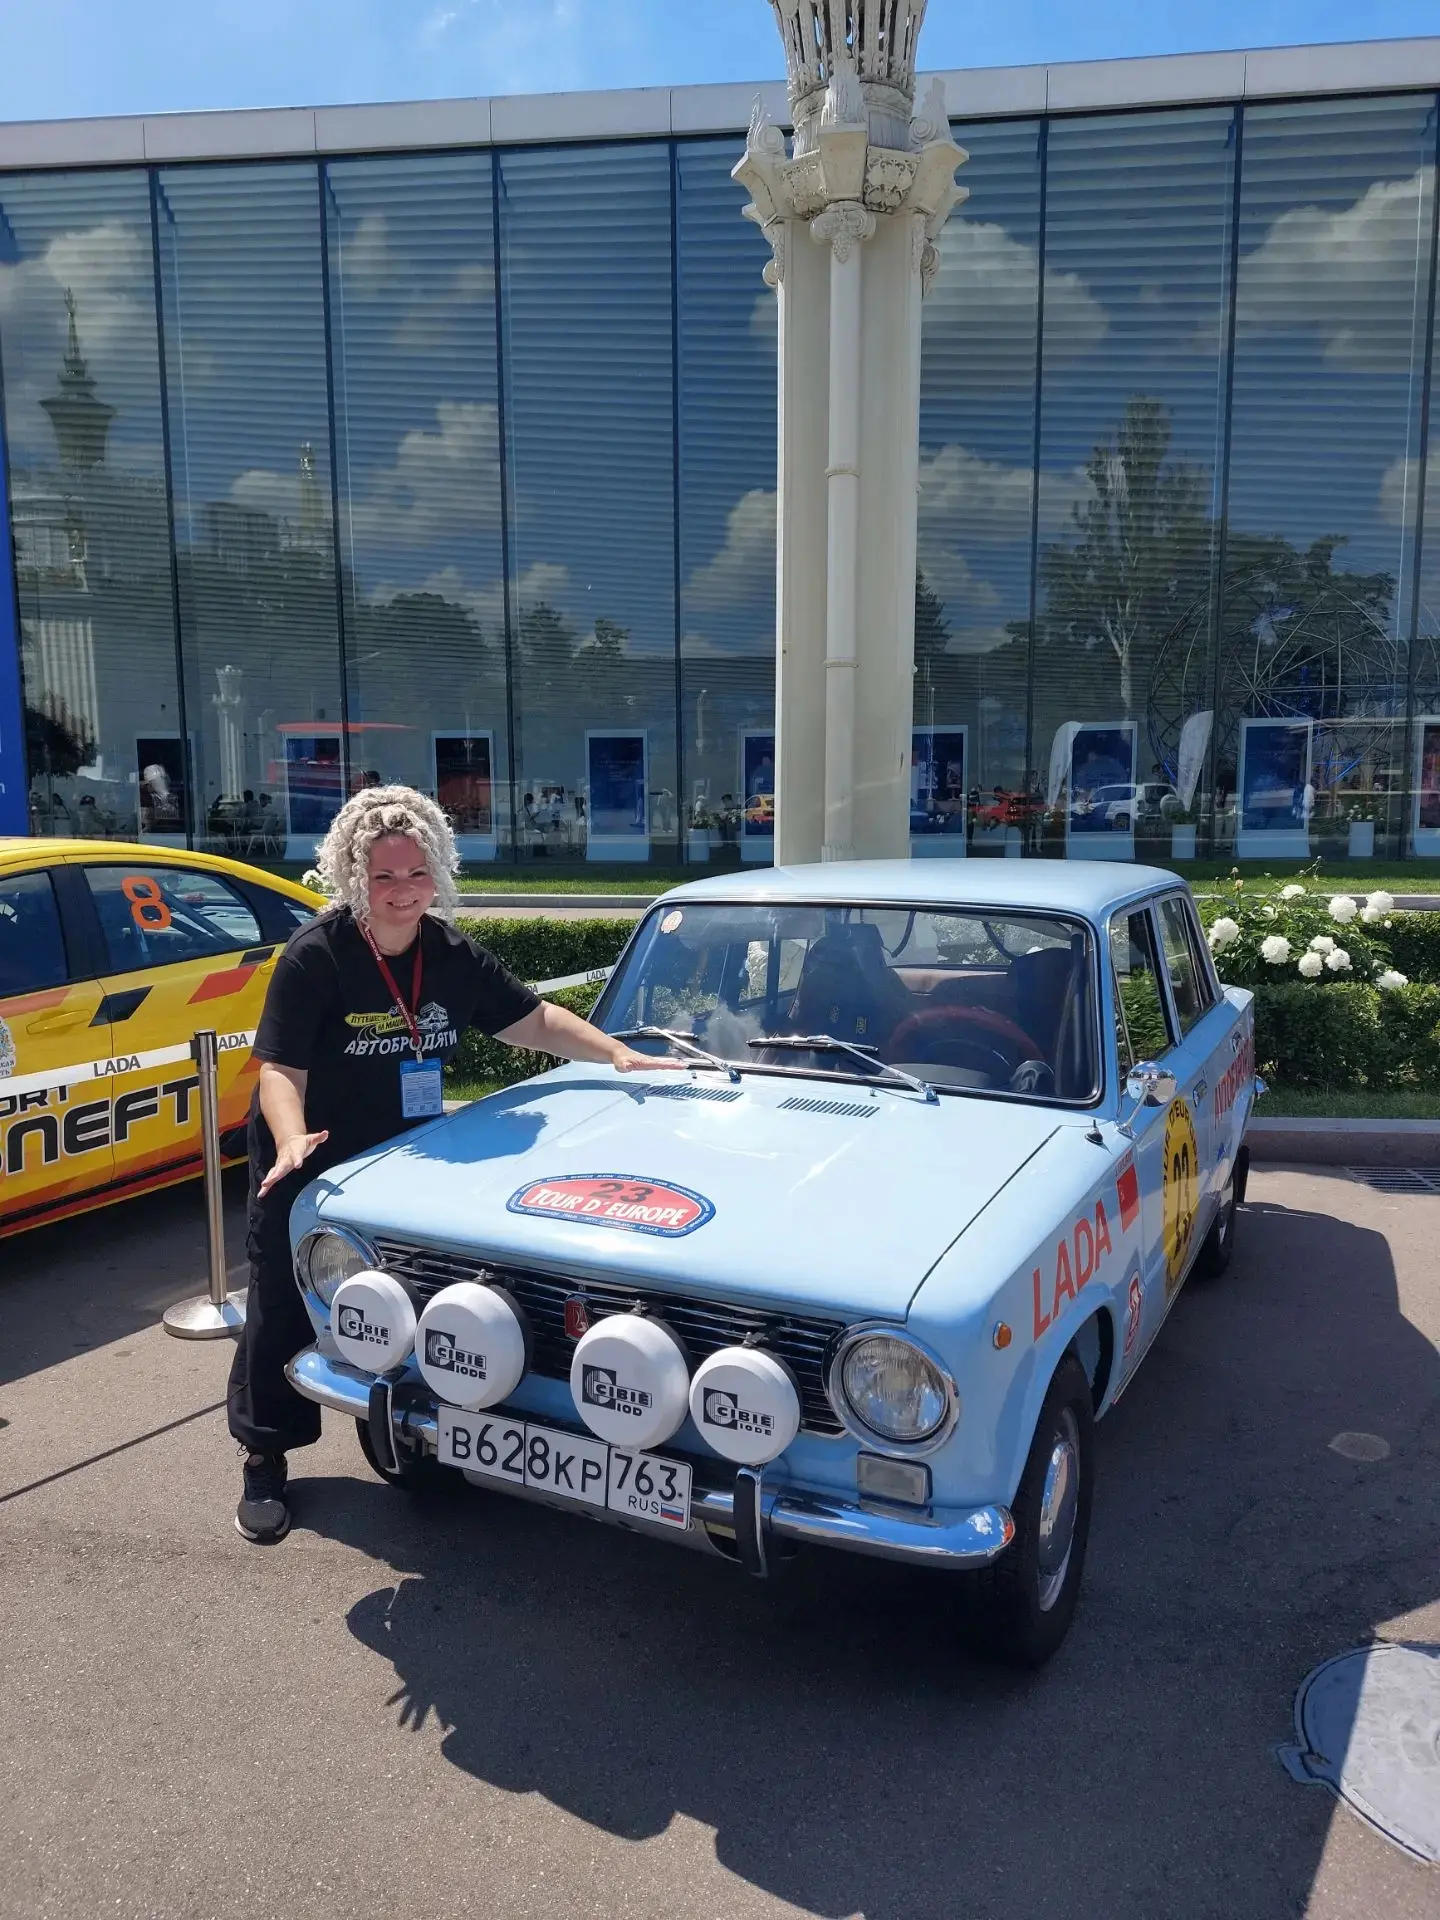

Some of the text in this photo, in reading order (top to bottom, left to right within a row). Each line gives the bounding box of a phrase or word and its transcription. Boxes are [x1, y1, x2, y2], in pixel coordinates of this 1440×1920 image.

[122, 876, 172, 929] 8
[586, 969, 607, 982] LADA
[218, 1033, 249, 1051] ADA
[344, 1029, 457, 1056] АВТОБРОДЯГИ
[93, 1055, 142, 1078] LADA
[588, 1181, 654, 1203] 23
[528, 1188, 584, 1210] TOUR
[586, 1198, 690, 1225] D'EUROPE
[1033, 1198, 1112, 1343] LADA
[456, 1364, 486, 1380] IODE
[617, 1402, 643, 1416] IOD
[614, 1453, 677, 1501] 763
[628, 1495, 660, 1514] RUS
